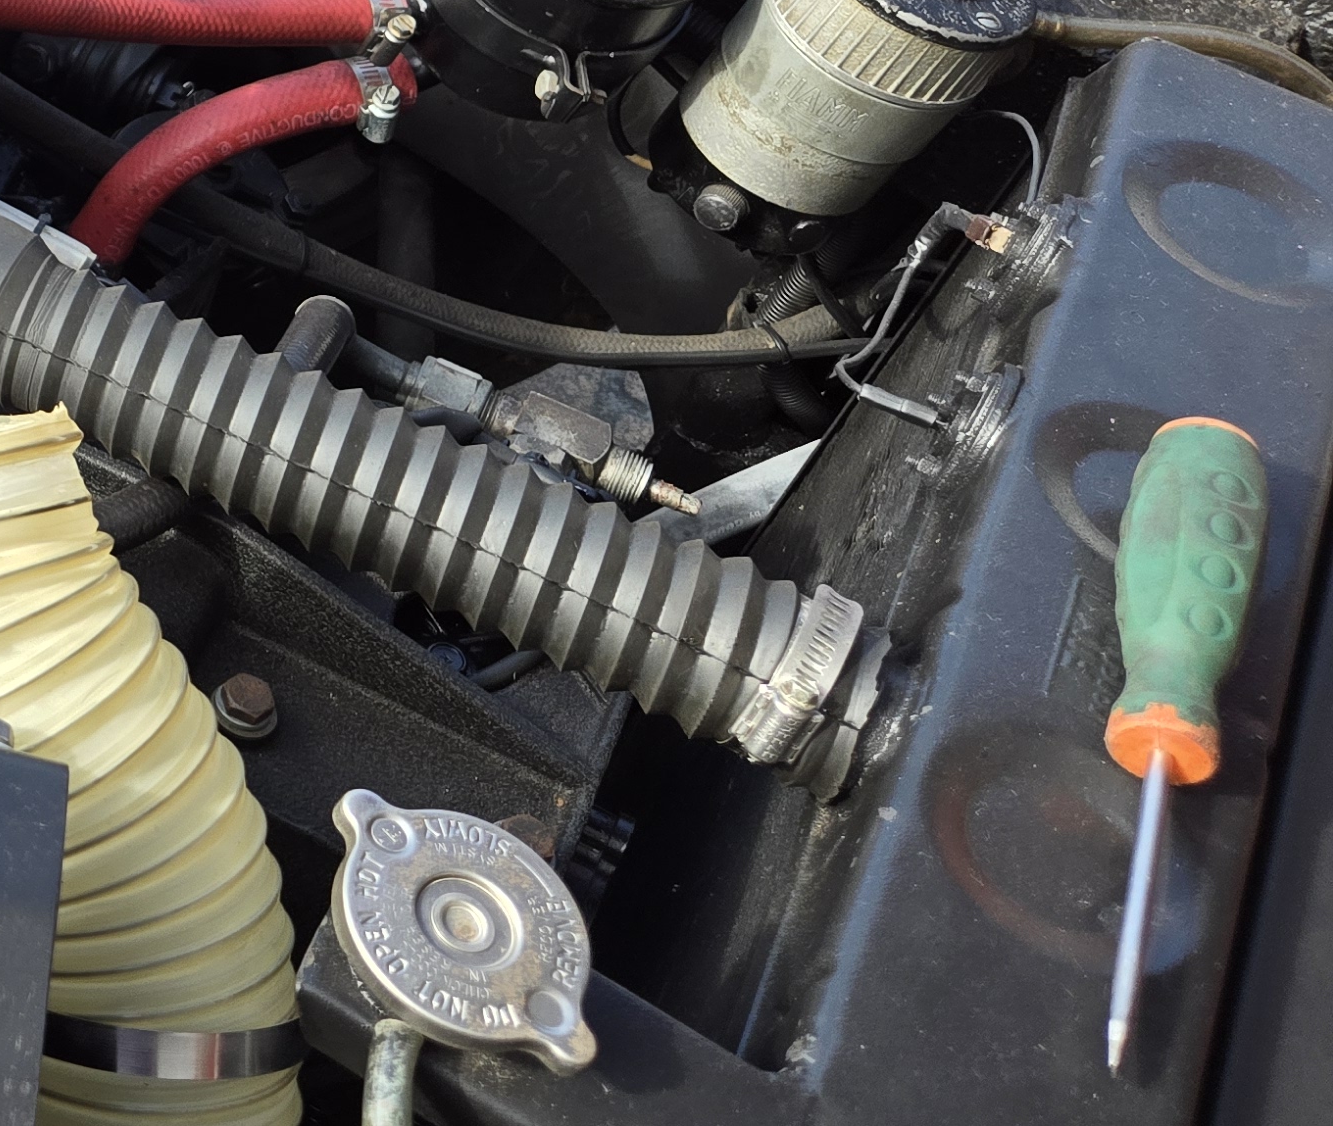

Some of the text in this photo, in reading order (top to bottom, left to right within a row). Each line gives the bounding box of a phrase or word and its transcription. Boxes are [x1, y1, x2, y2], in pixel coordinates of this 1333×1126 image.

[775, 66, 869, 134] FIAMM
[356, 850, 385, 901] HOT
[362, 910, 410, 975] OPEN
[551, 898, 583, 990] REMOVE
[412, 980, 469, 1023] NOT
[481, 1002, 521, 1029] DO
